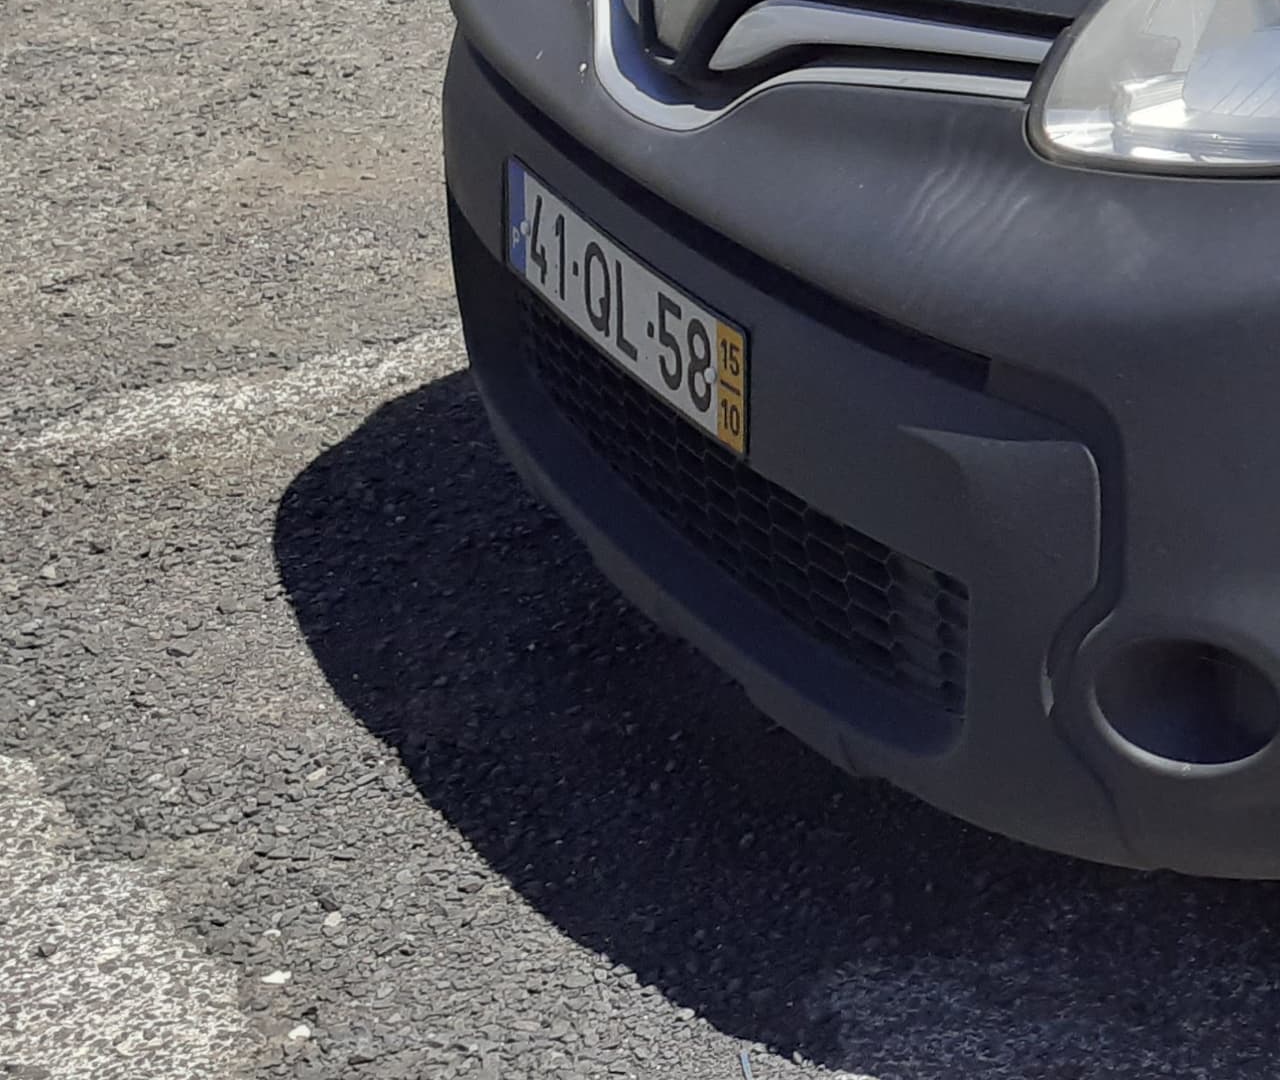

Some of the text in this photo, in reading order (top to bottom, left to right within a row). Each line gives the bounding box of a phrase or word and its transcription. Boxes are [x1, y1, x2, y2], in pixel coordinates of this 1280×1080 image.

[511, 224, 521, 250] P
[719, 338, 741, 377] 15
[719, 399, 741, 437] 10
